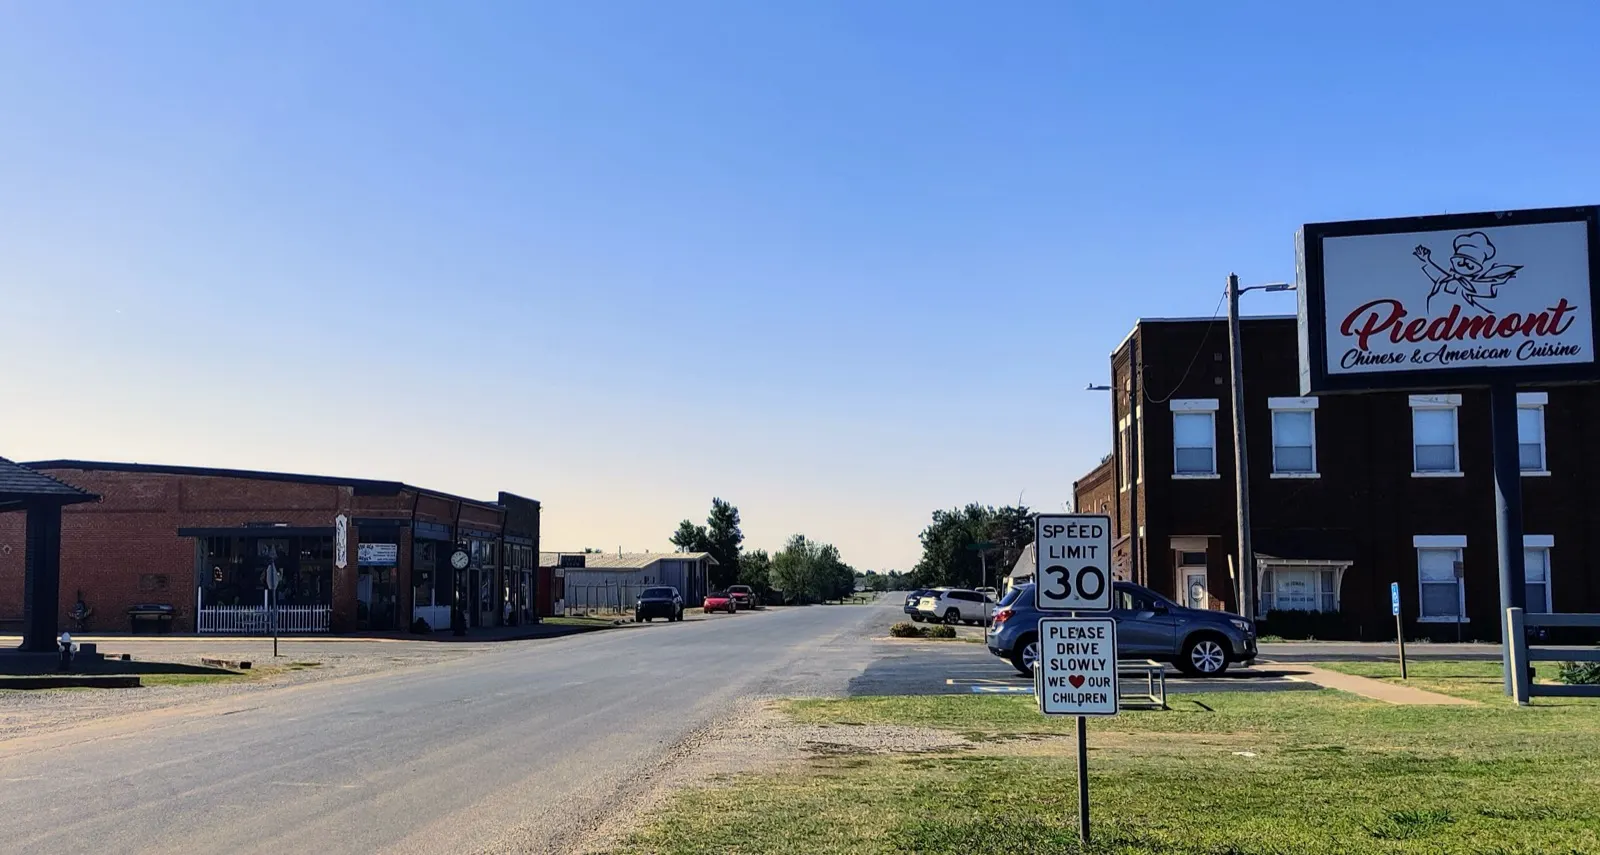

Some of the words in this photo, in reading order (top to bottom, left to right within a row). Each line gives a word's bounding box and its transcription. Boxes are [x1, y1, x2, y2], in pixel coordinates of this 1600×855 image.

[1340, 298, 1578, 351] Piedmont
[1341, 348, 1405, 369] Chinese
[1516, 340, 1581, 361] Cuisine
[1042, 524, 1103, 539] SPEED
[1049, 545, 1098, 559] LIMIT
[1043, 565, 1105, 600] 30
[1050, 627, 1105, 639] PLEASE
[1056, 643, 1099, 655] DRIVE
[1050, 658, 1106, 671] SLOWLY
[1048, 676, 1066, 687] WE
[1088, 676, 1110, 688] OUR
[1052, 692, 1107, 705] CHILDREN
